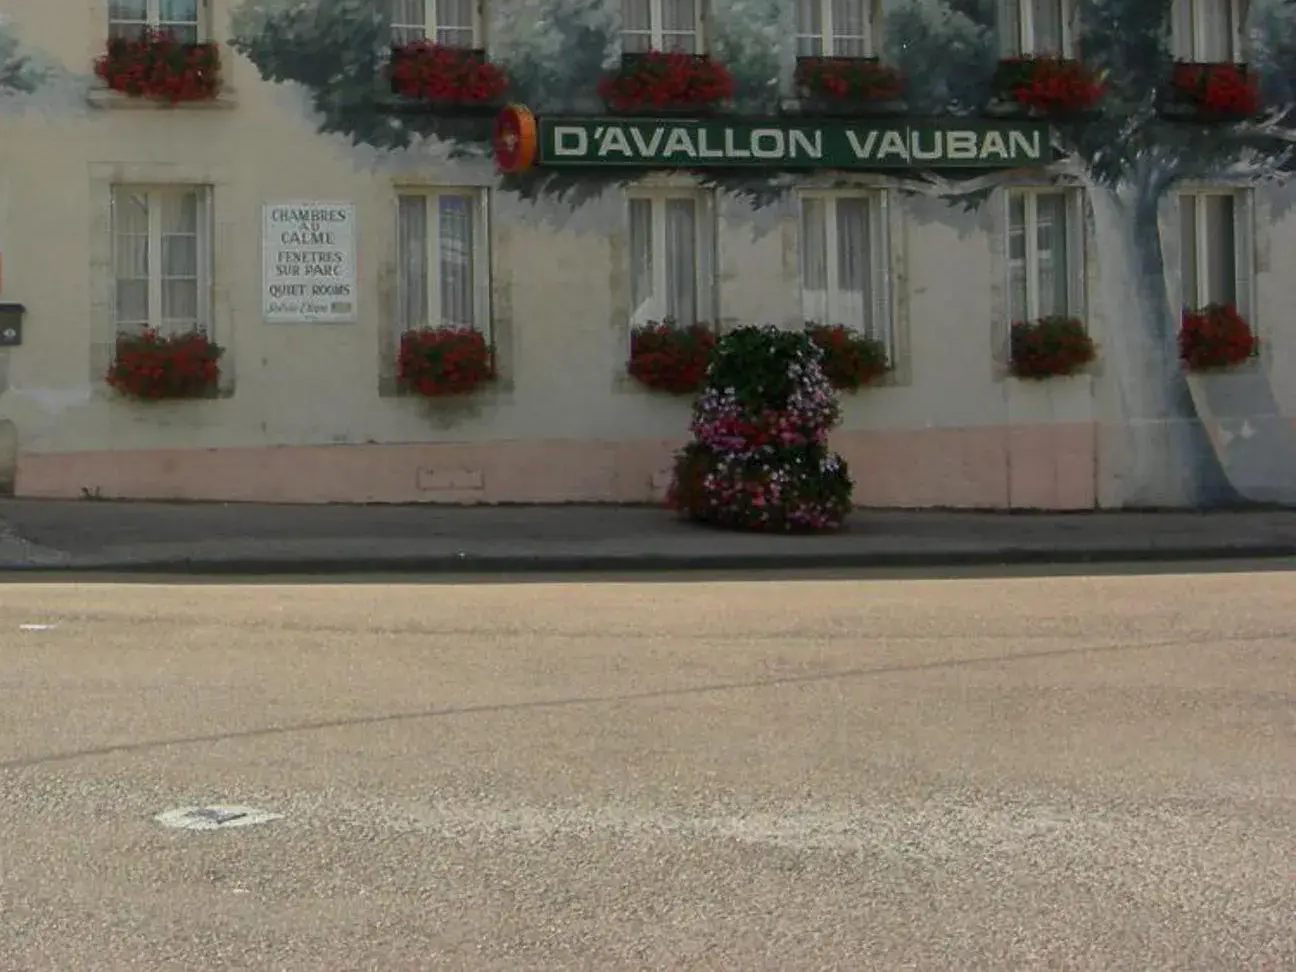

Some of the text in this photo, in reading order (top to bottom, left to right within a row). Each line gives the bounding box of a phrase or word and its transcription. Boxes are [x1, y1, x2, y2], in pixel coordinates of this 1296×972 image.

[553, 126, 1042, 162] D'AVALLON VAUBAN
[272, 209, 347, 222] CHAMBRES
[281, 231, 334, 245] CALME
[275, 265, 342, 277] SUR PARC
[268, 284, 351, 298] QUIET ROOMS
